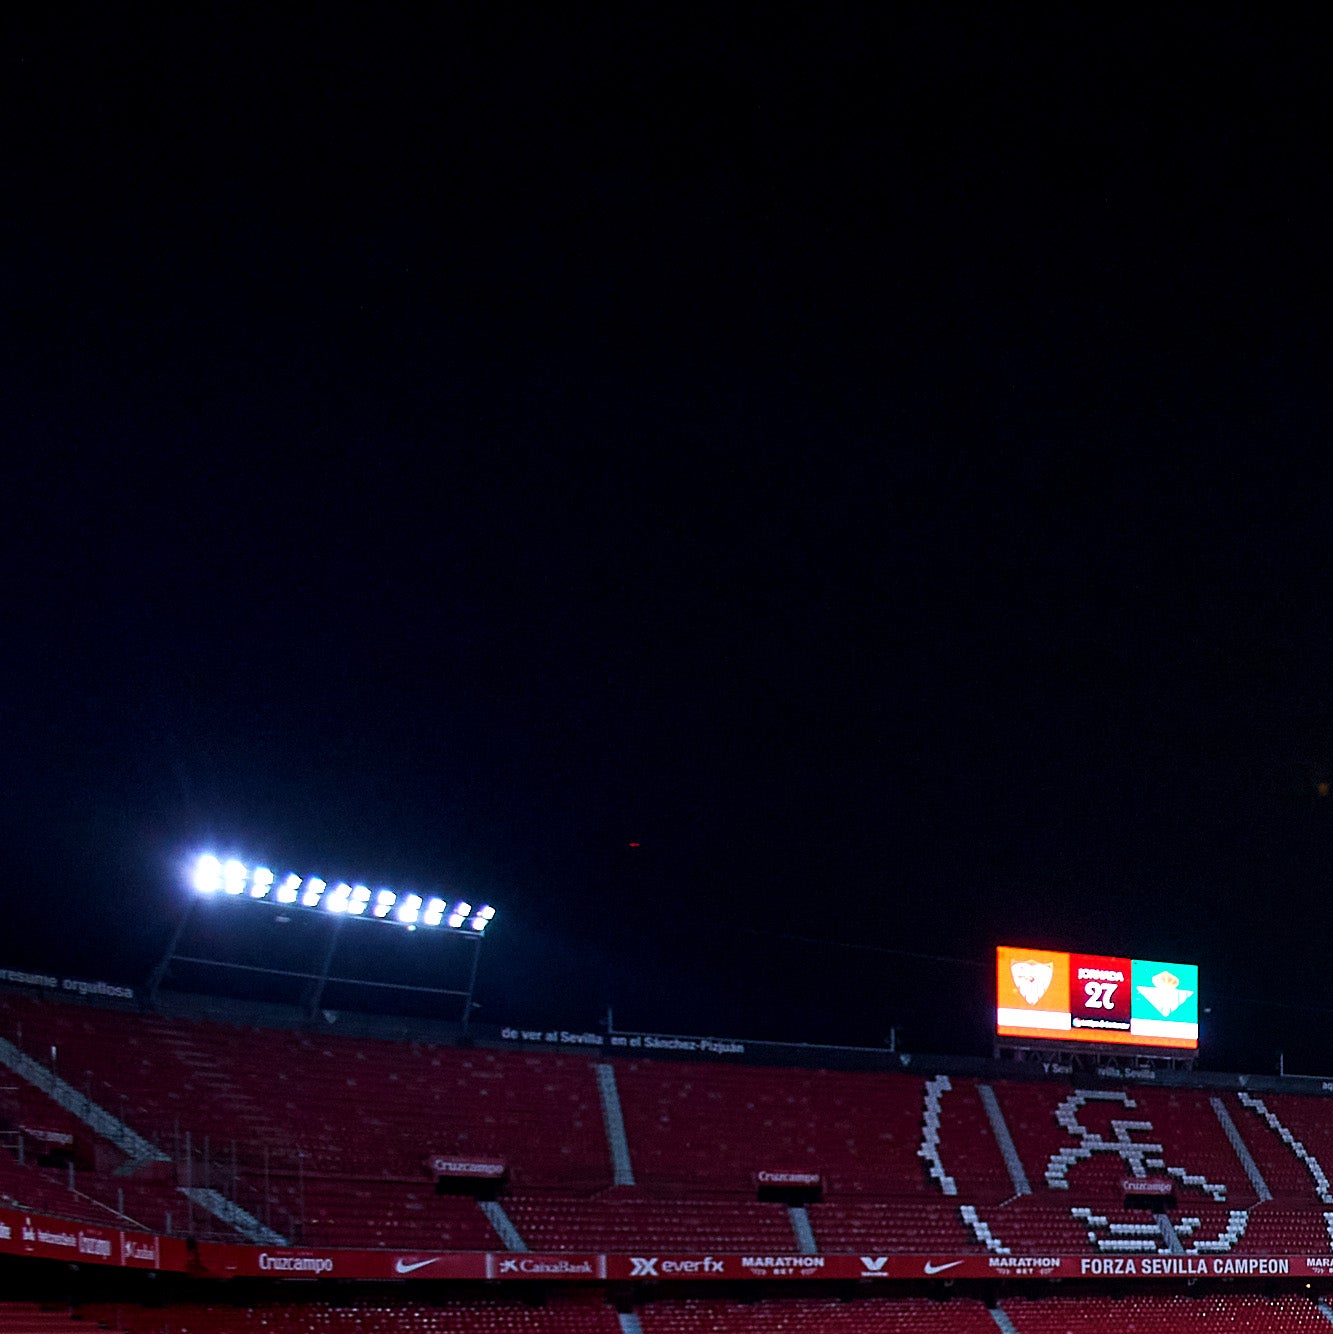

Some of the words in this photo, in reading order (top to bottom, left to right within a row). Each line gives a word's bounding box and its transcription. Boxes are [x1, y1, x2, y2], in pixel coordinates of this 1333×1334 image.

[1084, 982, 1118, 1010] 27
[560, 1031, 605, 1046] Sevilla
[1123, 1180, 1172, 1193] Cruzcampo
[259, 1252, 334, 1275] Cruzcampo
[520, 1258, 593, 1274] CaixaBank
[661, 1256, 724, 1273] everfx
[741, 1256, 825, 1268] MARATHON
[988, 1256, 1060, 1268] MARATHON
[1081, 1258, 1136, 1275] FORZA
[1141, 1258, 1208, 1275] SEVILLA
[1213, 1257, 1290, 1275] CAMPEON
